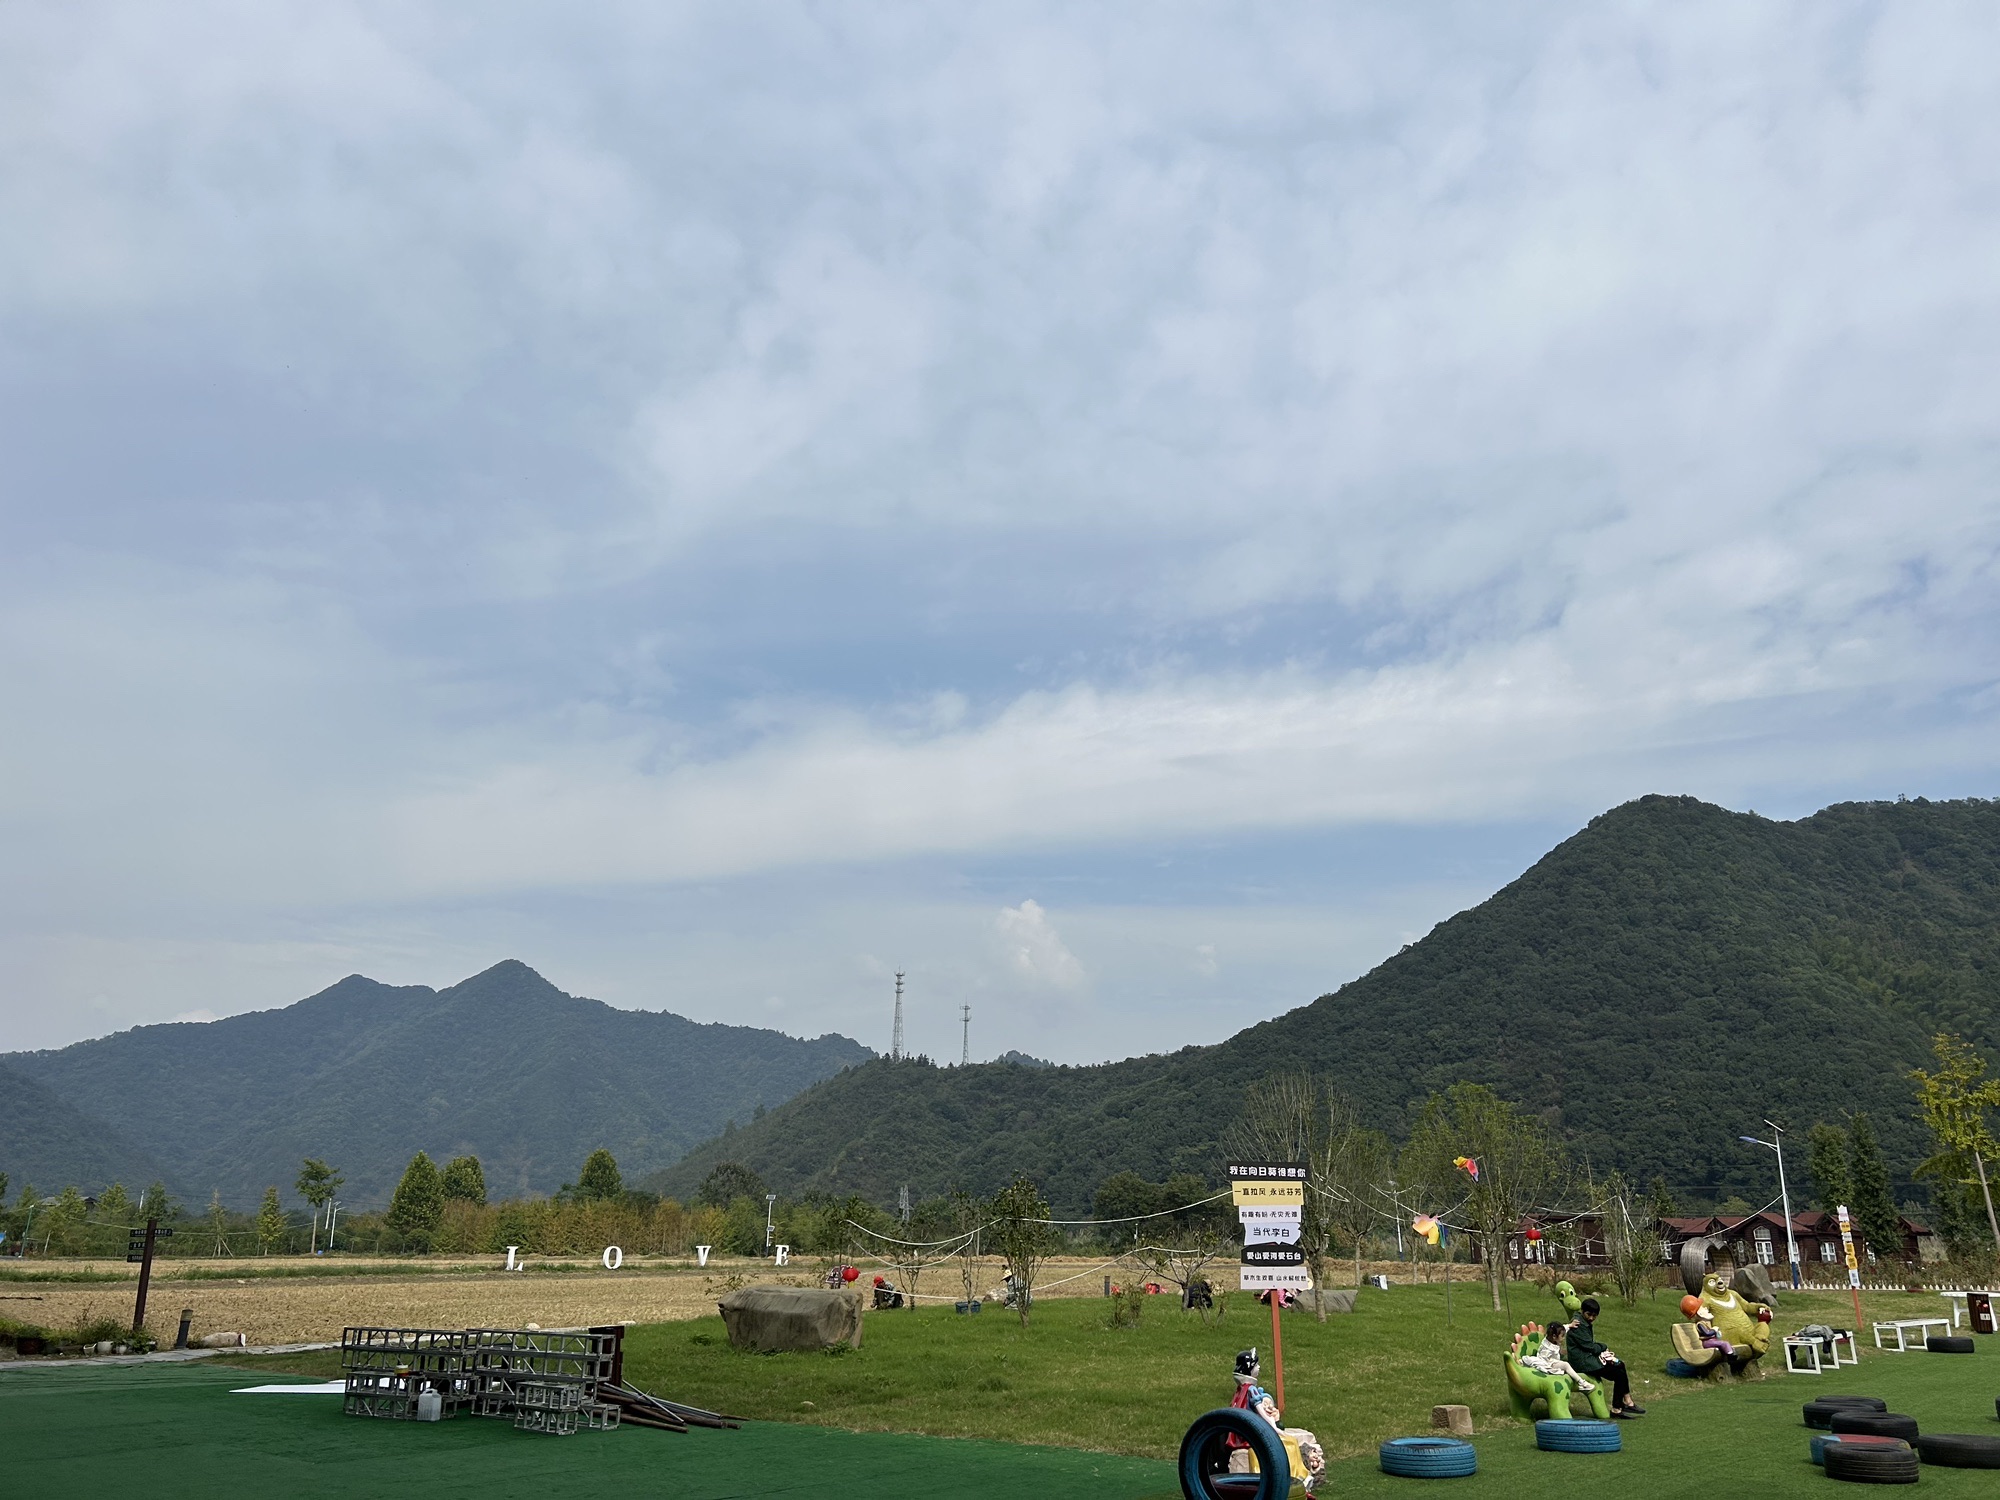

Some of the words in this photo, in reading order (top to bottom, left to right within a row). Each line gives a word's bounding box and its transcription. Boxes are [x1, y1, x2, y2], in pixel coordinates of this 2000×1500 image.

[1229, 1165, 1306, 1178] 我在向日葵很想你
[1234, 1187, 1266, 1196] 一直拉风
[1269, 1187, 1302, 1197] 永远芬芳
[1253, 1227, 1290, 1237] 当代李白
